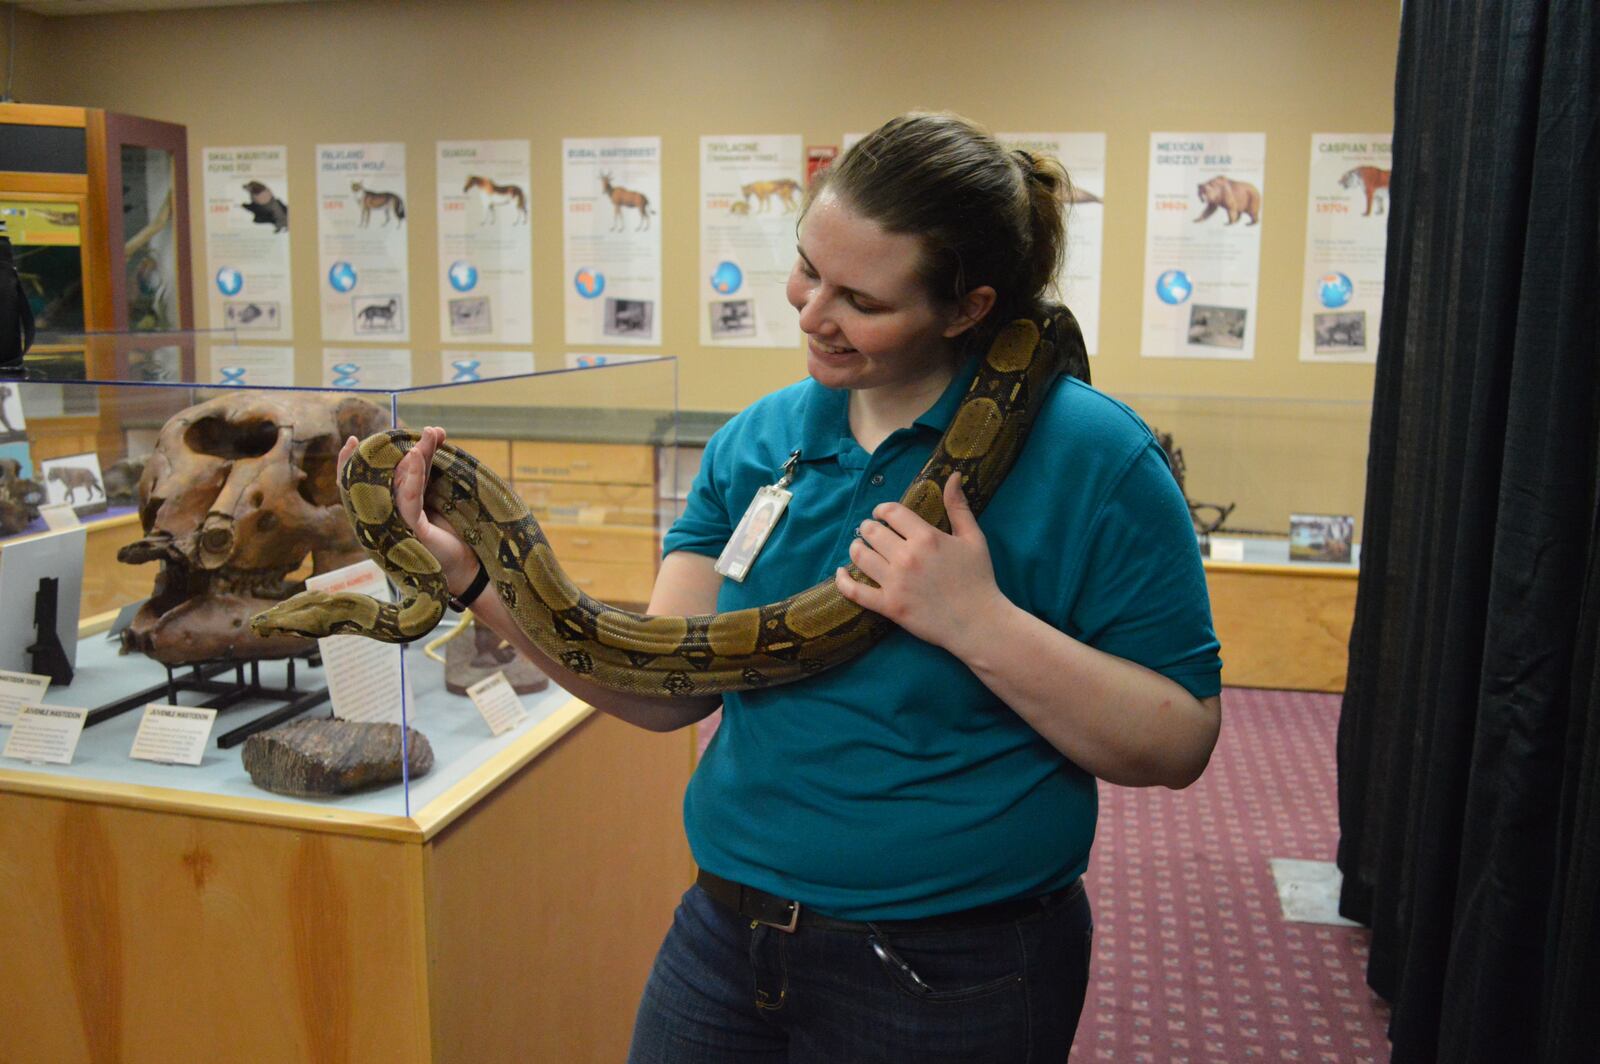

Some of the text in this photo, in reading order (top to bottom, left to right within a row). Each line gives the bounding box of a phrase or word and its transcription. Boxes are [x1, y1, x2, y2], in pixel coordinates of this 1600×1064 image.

[1157, 142, 1204, 151] MEXICAN
[1319, 143, 1367, 152] CASPIAN
[1157, 154, 1232, 164] GRIZZLY BEAR
[49, 708, 81, 719] MASTODON
[176, 710, 209, 720] MASTODON
